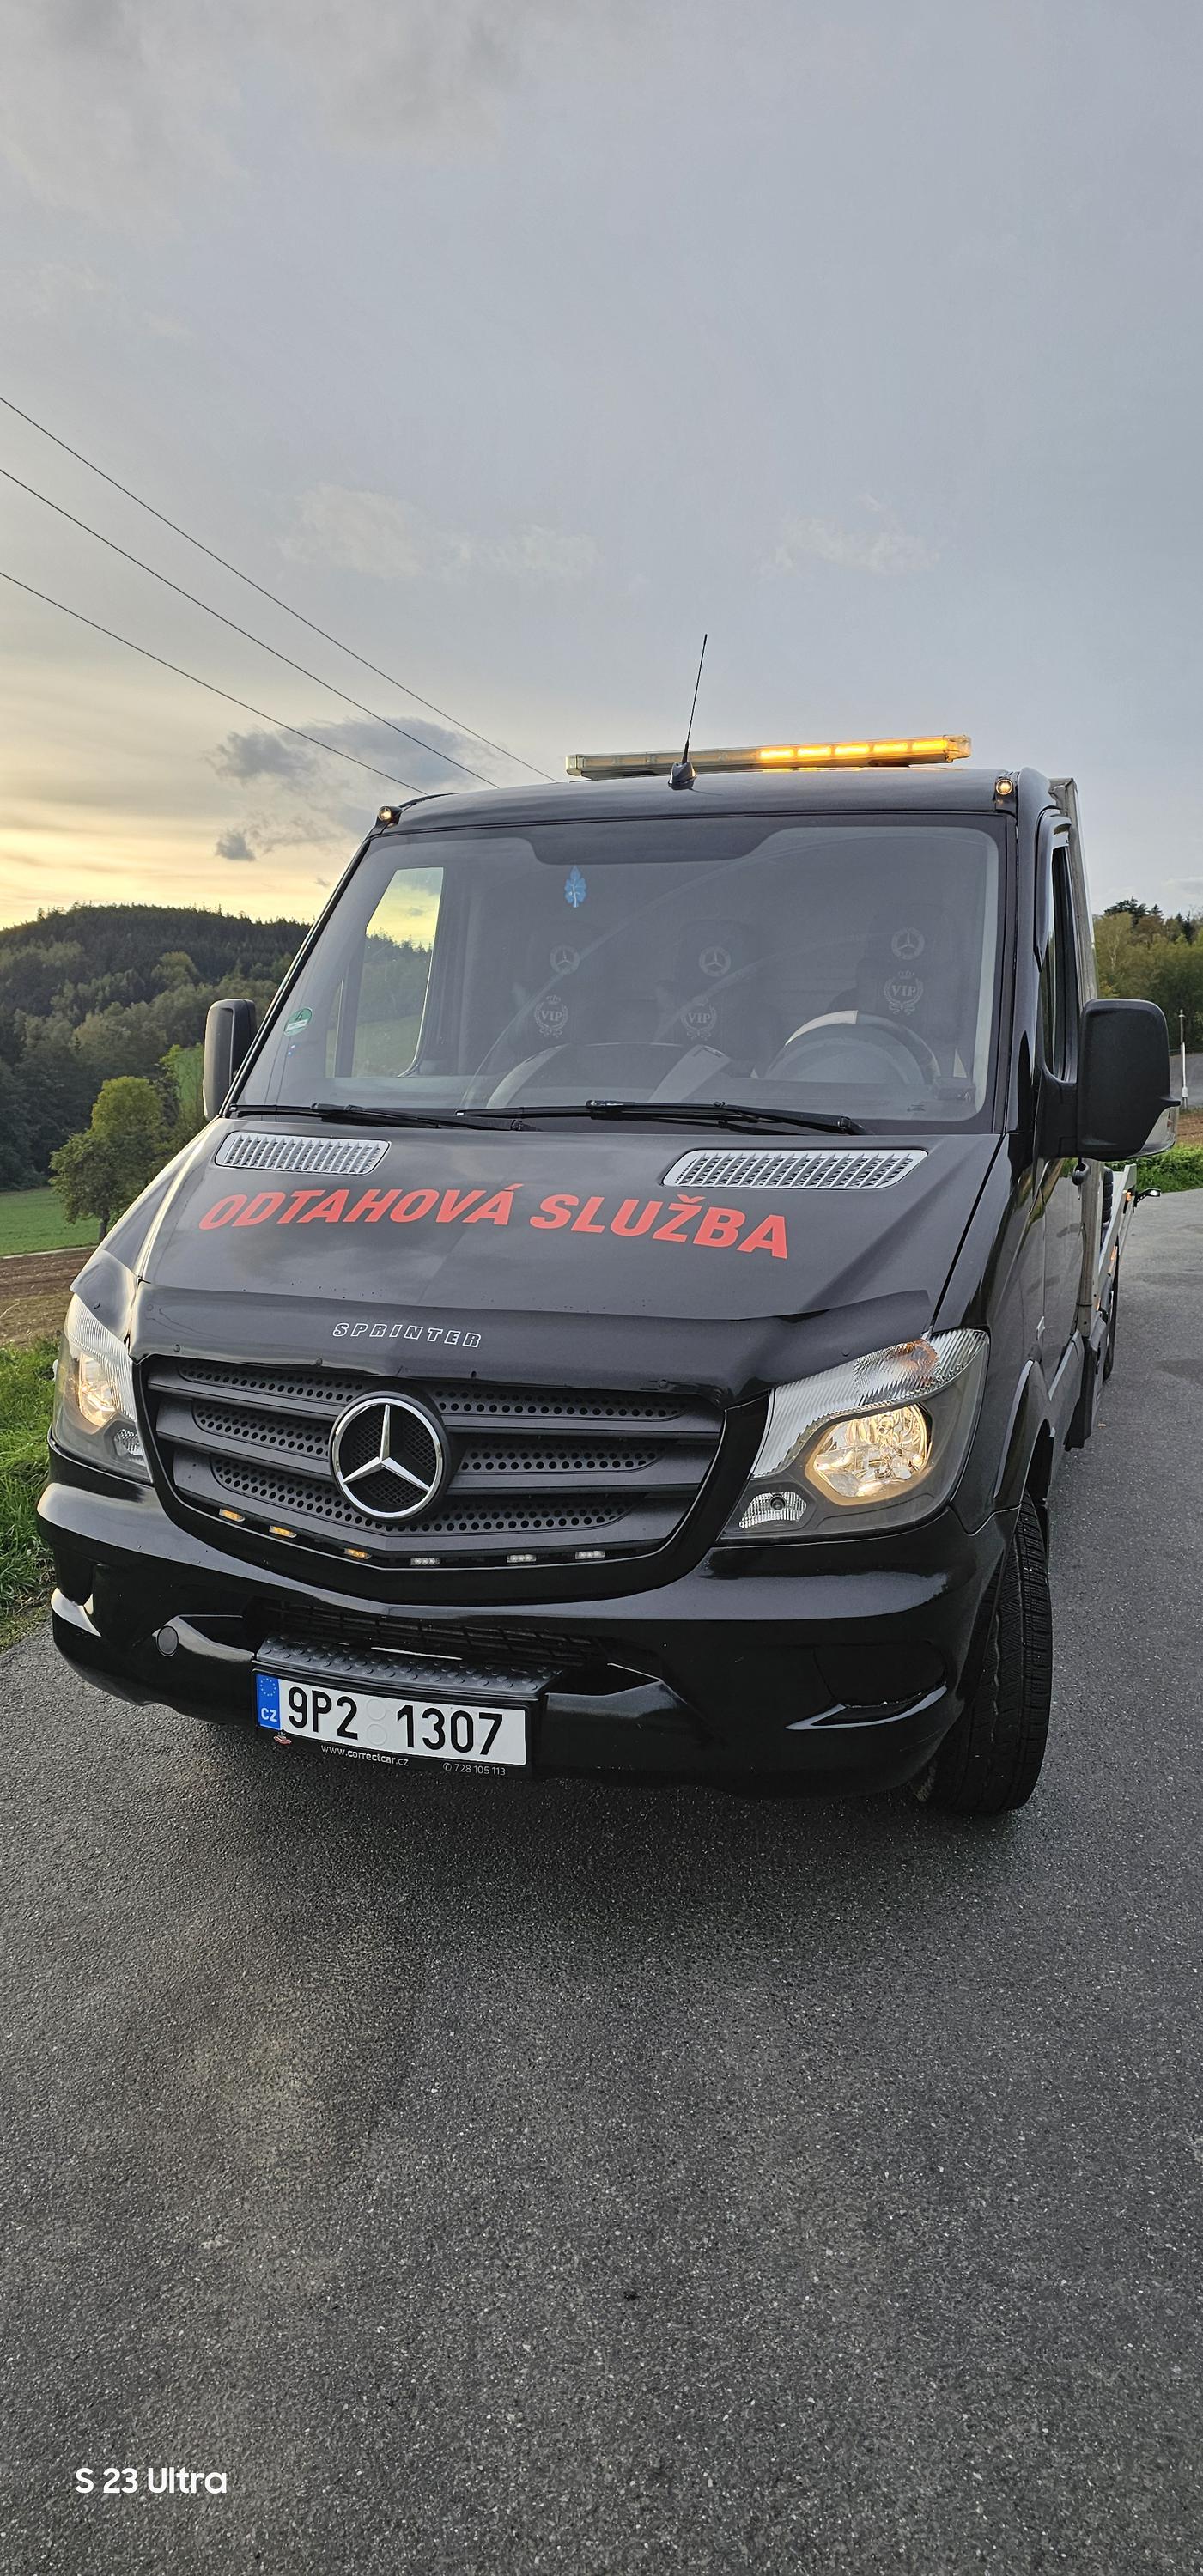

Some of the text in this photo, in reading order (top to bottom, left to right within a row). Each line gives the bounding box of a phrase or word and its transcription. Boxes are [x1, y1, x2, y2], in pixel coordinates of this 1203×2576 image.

[892, 985, 916, 997] VIP
[540, 1011, 563, 1022] VIP
[688, 1012, 711, 1024] VIP
[198, 1184, 788, 1259] ODTAHOVÁ SLUŽBA
[332, 1322, 482, 1348] SPRINTER
[260, 1707, 278, 1722] CZ
[288, 1686, 503, 1755] 9P2 1307
[320, 1744, 410, 1767] www.correctcar.cz
[454, 1764, 506, 1776] 728 105 113
